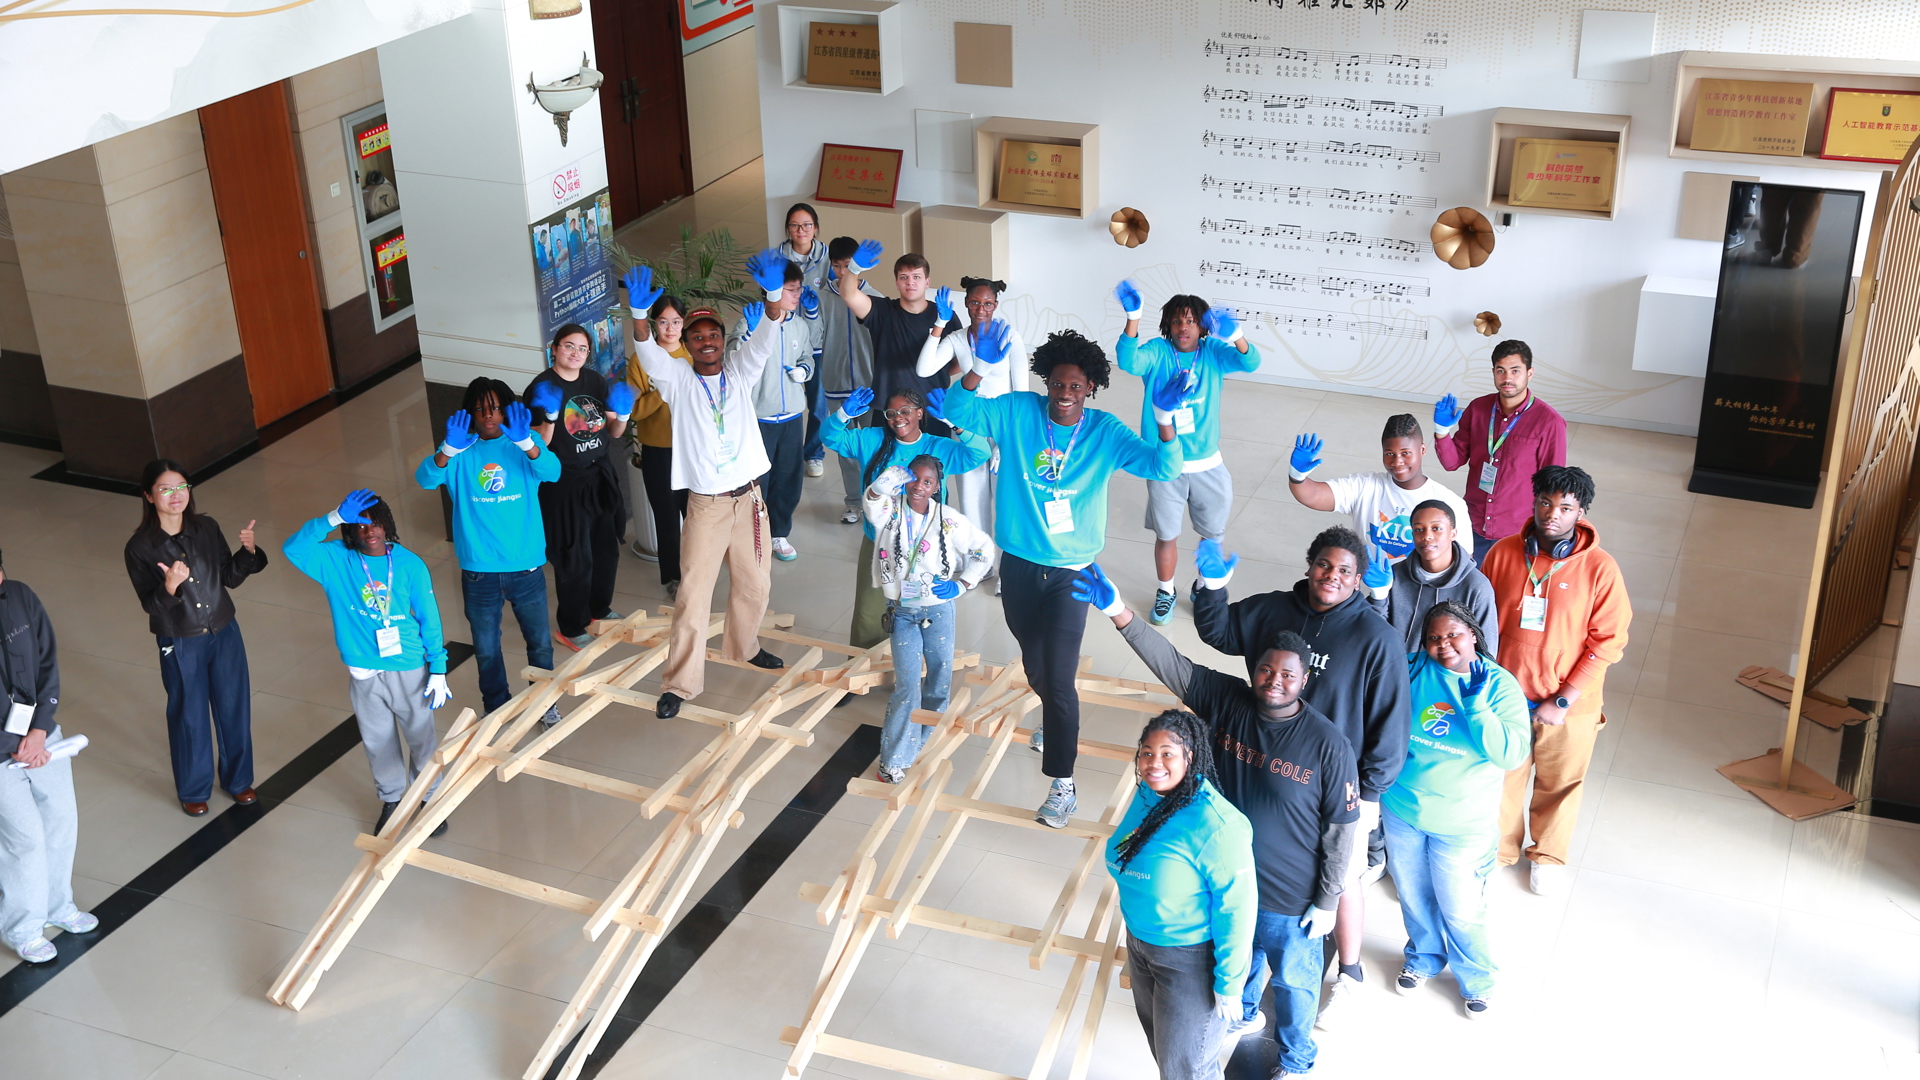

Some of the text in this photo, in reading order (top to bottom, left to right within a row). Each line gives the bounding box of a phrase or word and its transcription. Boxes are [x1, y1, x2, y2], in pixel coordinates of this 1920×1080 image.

[814, 45, 880, 60] 江苏省四星级普通高
[1705, 92, 1804, 106] 江苏省青少年科技创新基地
[1843, 120, 1920, 132] 人工智能教育示范基
[566, 167, 580, 181] 禁止
[831, 166, 885, 183] 先进集体
[1545, 163, 1584, 174] 科创筑梦
[567, 179, 580, 192] 吸烟
[1526, 172, 1601, 185] 青少年科学工作室
[576, 437, 603, 453] NASA
[1269, 757, 1314, 785] COLE
